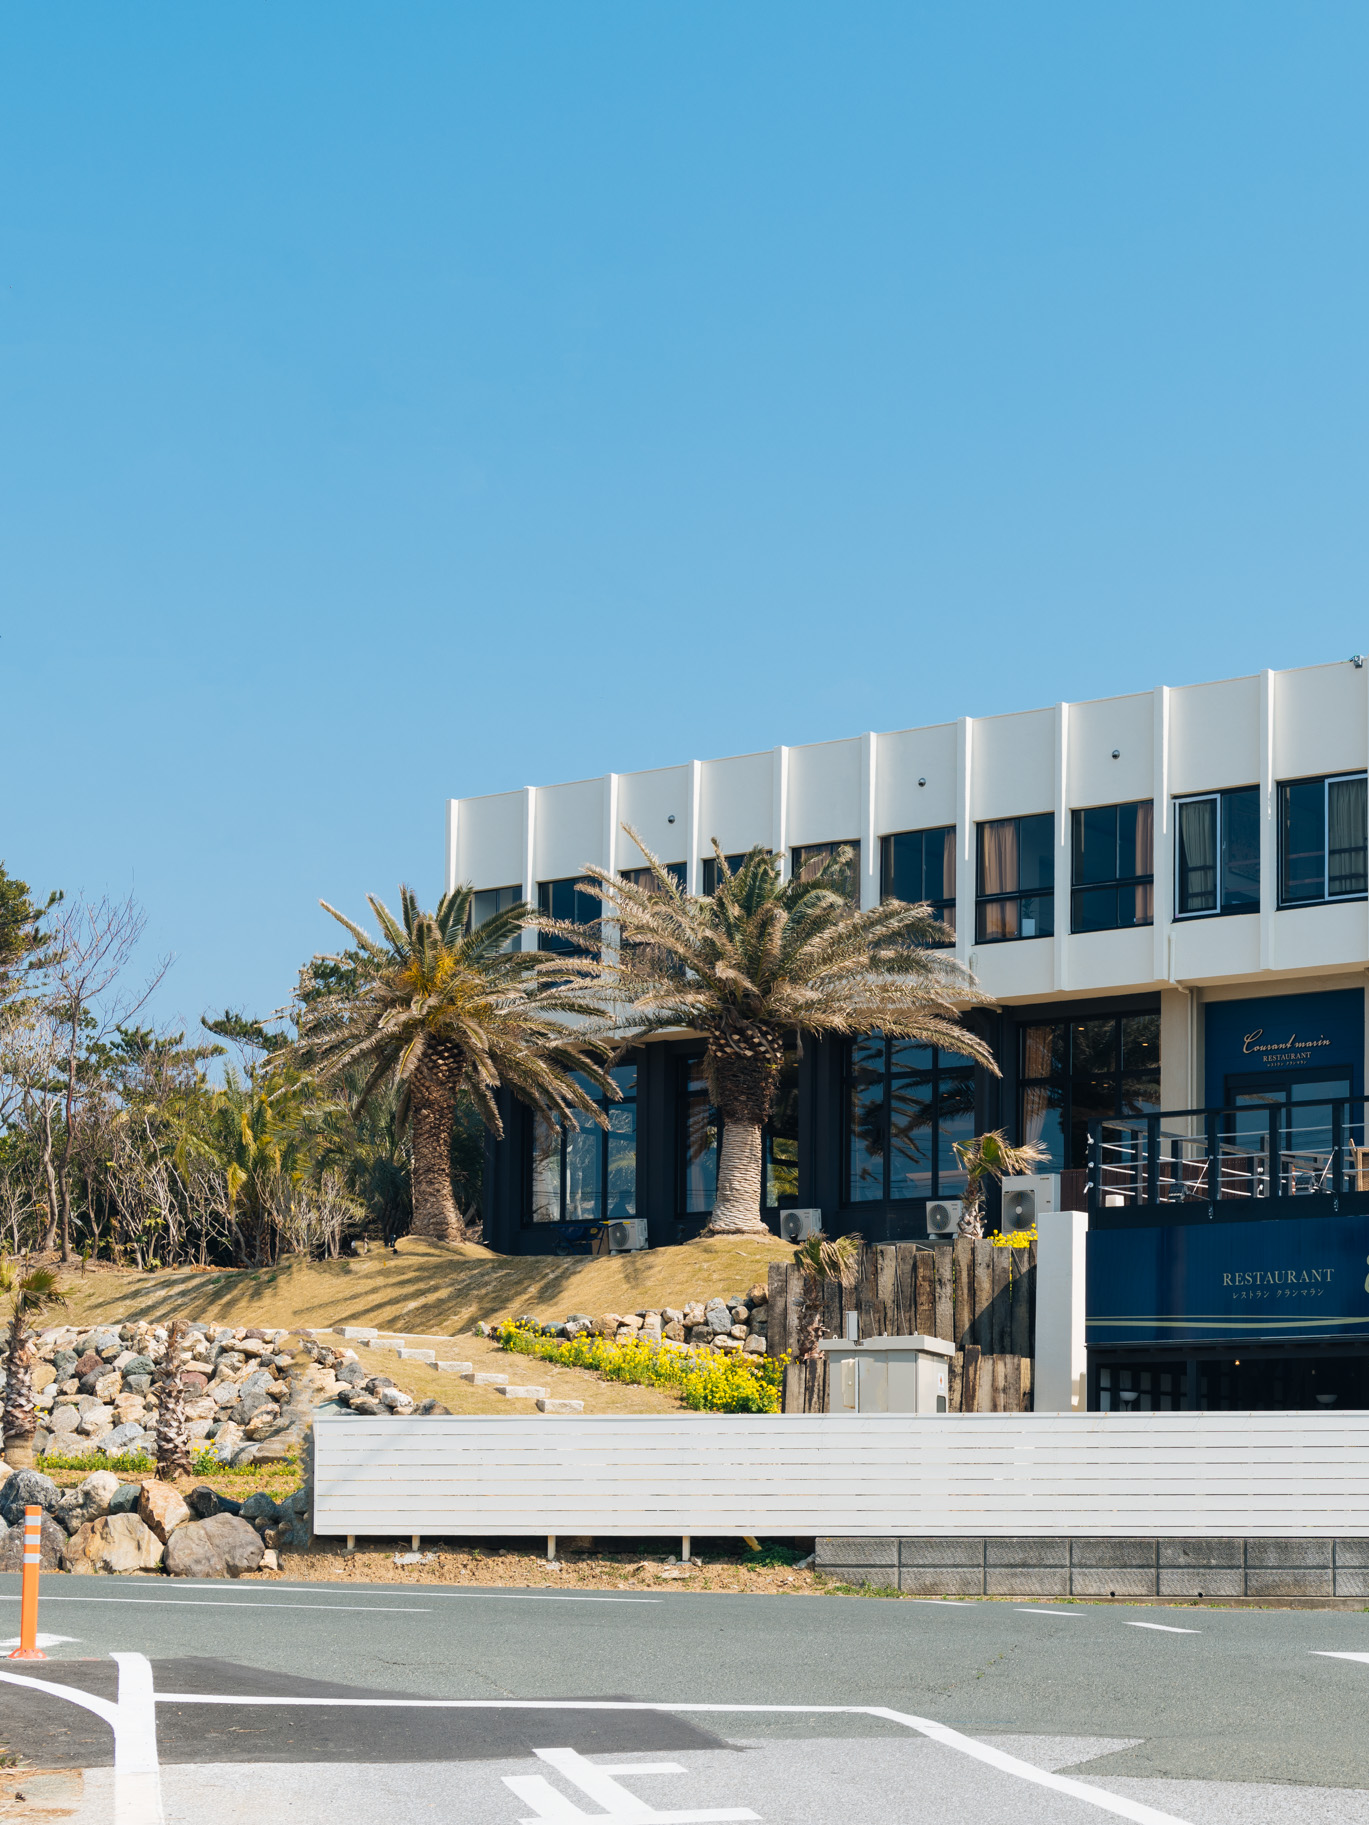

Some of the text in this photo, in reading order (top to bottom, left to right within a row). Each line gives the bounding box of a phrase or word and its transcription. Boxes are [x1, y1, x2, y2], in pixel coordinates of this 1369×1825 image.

[1243, 1028, 1331, 1054] Courant marin
[1262, 1051, 1312, 1062] RESTAURANT
[1222, 1268, 1335, 1286] RESTAURANT
[1232, 1287, 1324, 1299] レストラン クランマラン
